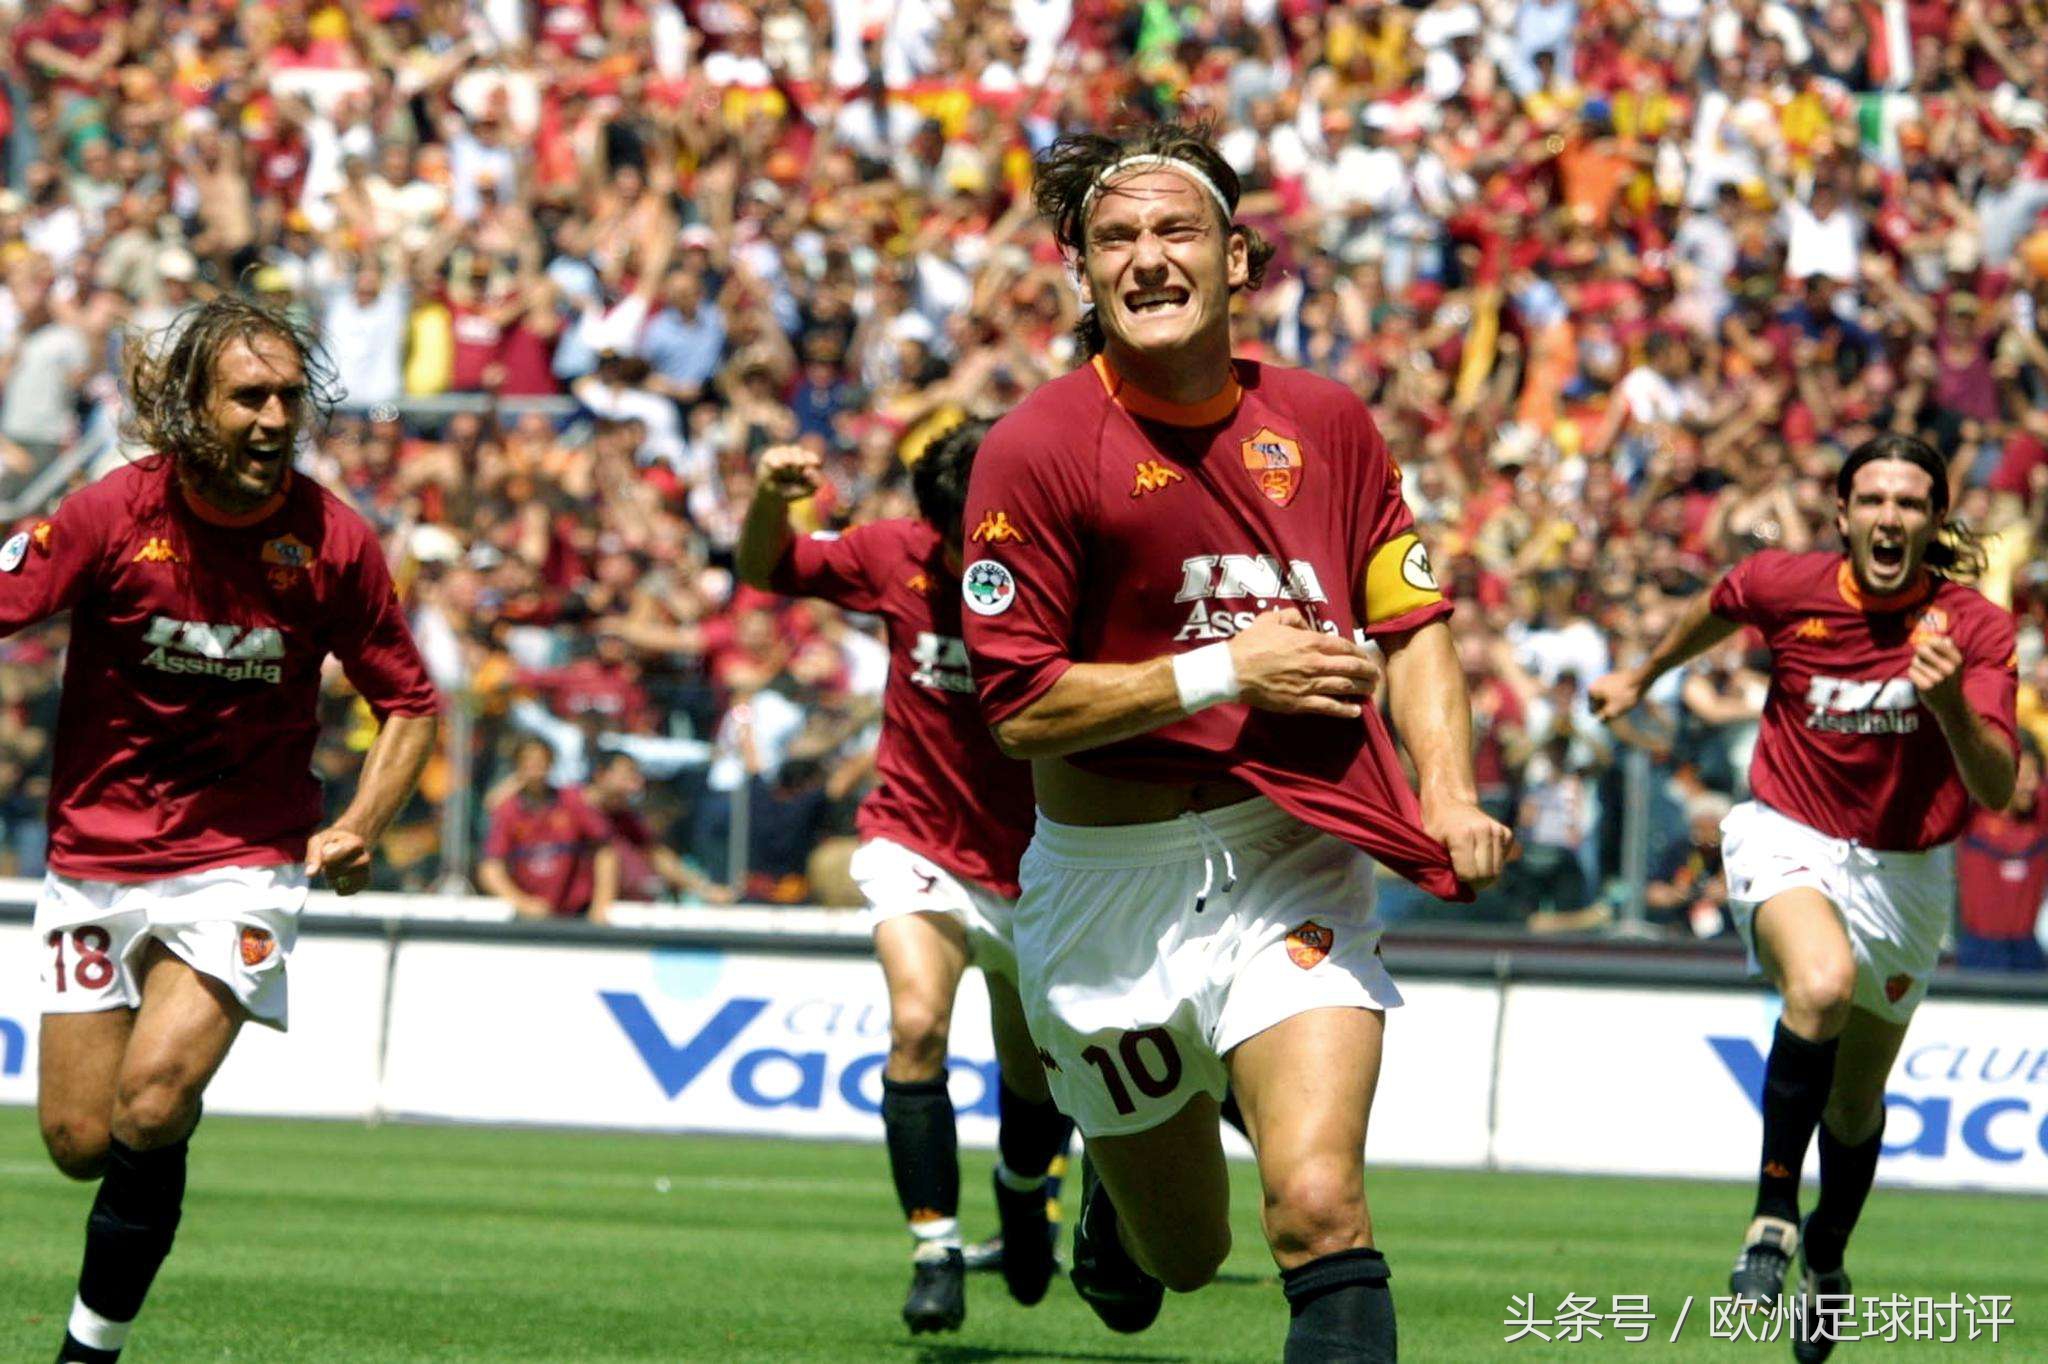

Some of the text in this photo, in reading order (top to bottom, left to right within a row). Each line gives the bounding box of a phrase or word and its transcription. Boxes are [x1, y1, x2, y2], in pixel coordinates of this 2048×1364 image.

[1175, 553, 1328, 605] INA
[141, 647, 282, 684] Assitalia
[47, 925, 114, 993] 18
[1081, 1027, 1182, 1115] 10
